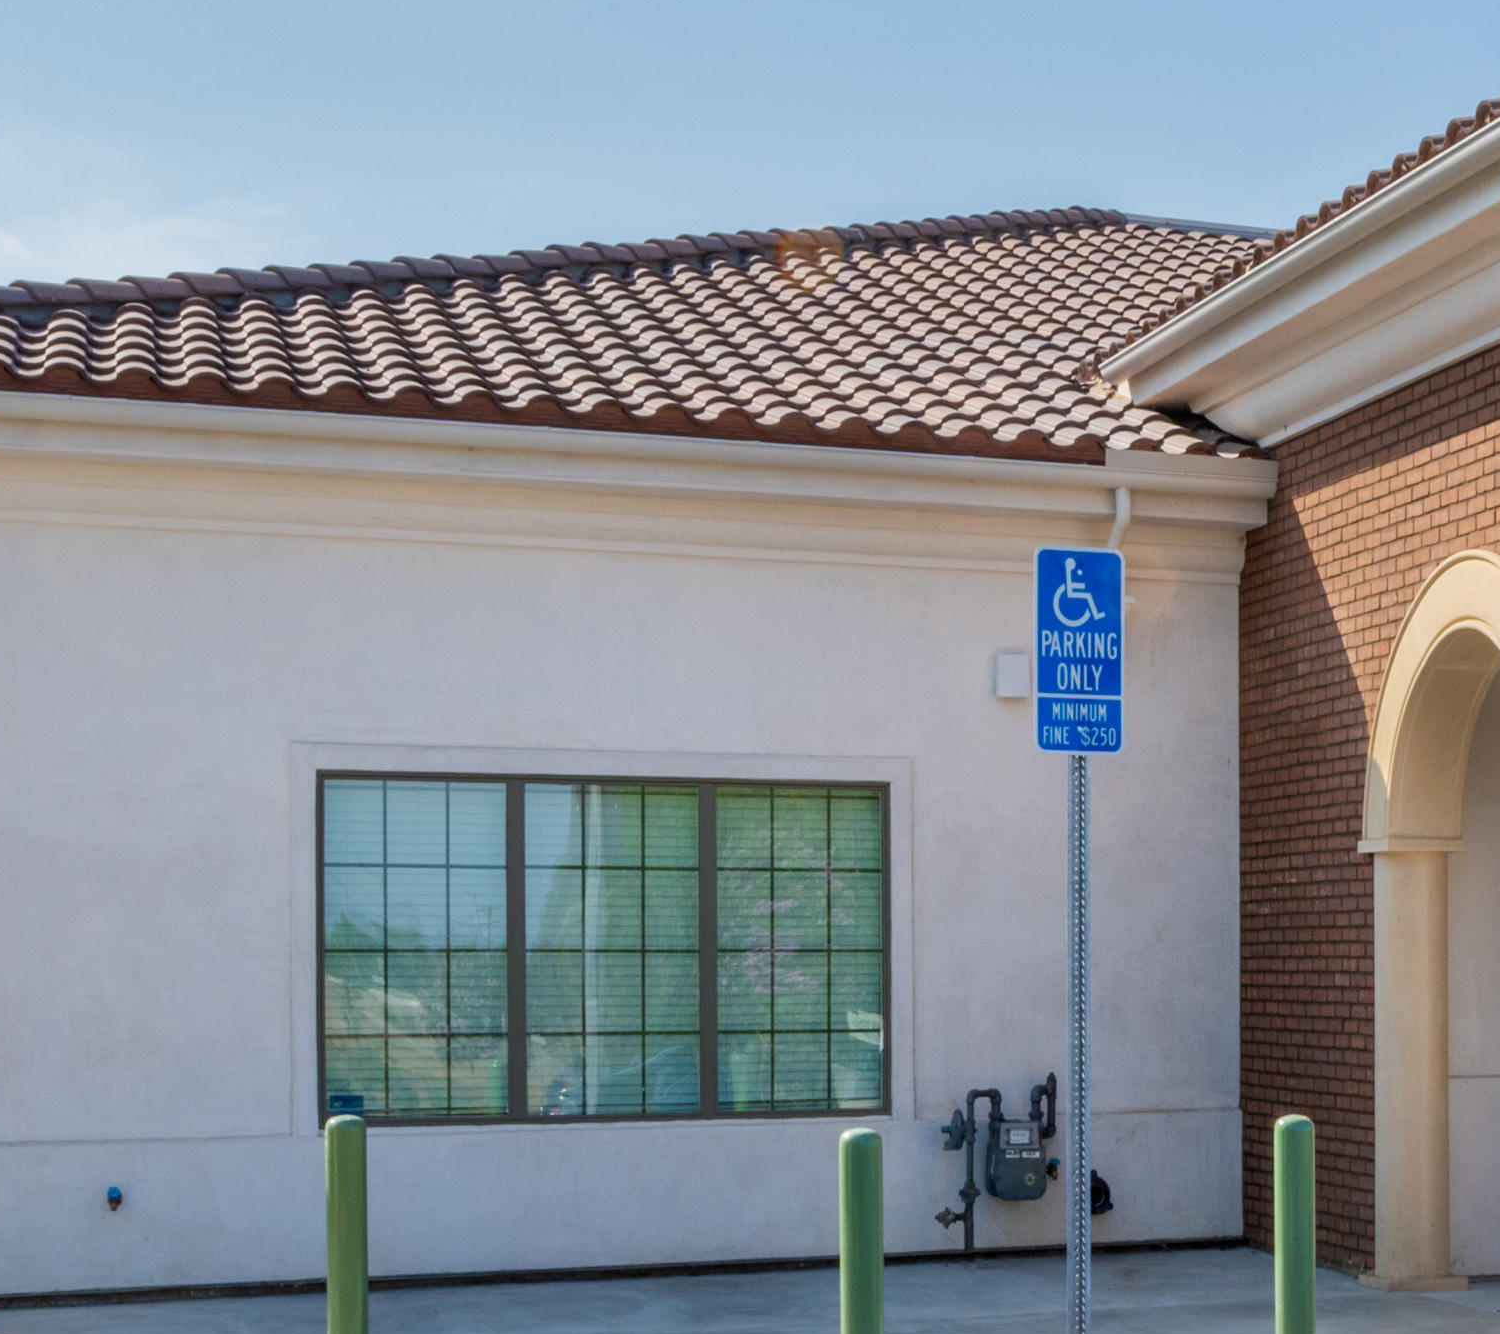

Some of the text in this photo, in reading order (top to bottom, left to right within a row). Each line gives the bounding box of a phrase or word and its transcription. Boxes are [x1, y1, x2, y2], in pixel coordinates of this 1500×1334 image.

[1041, 630, 1118, 660] PARKING
[1057, 662, 1102, 691] ONLY
[1052, 702, 1107, 722] MINIMUM
[1043, 726, 1116, 746] FINE $250
